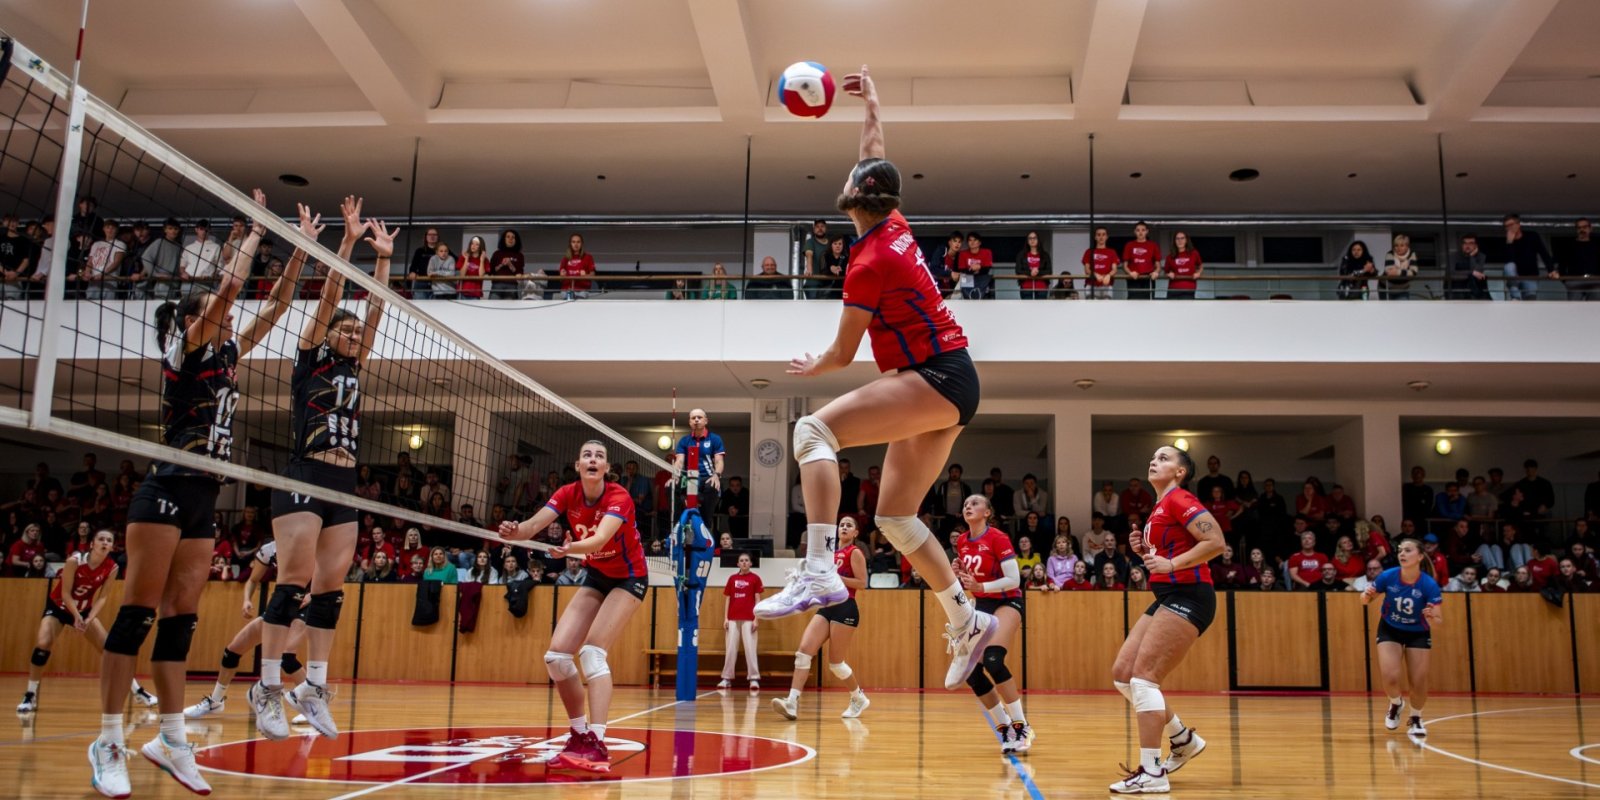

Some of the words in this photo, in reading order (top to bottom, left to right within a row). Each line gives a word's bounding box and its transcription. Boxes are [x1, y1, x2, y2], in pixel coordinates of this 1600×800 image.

[331, 374, 359, 410] 17
[963, 554, 985, 576] 22
[74, 584, 93, 596] 5
[1393, 596, 1414, 615] 13
